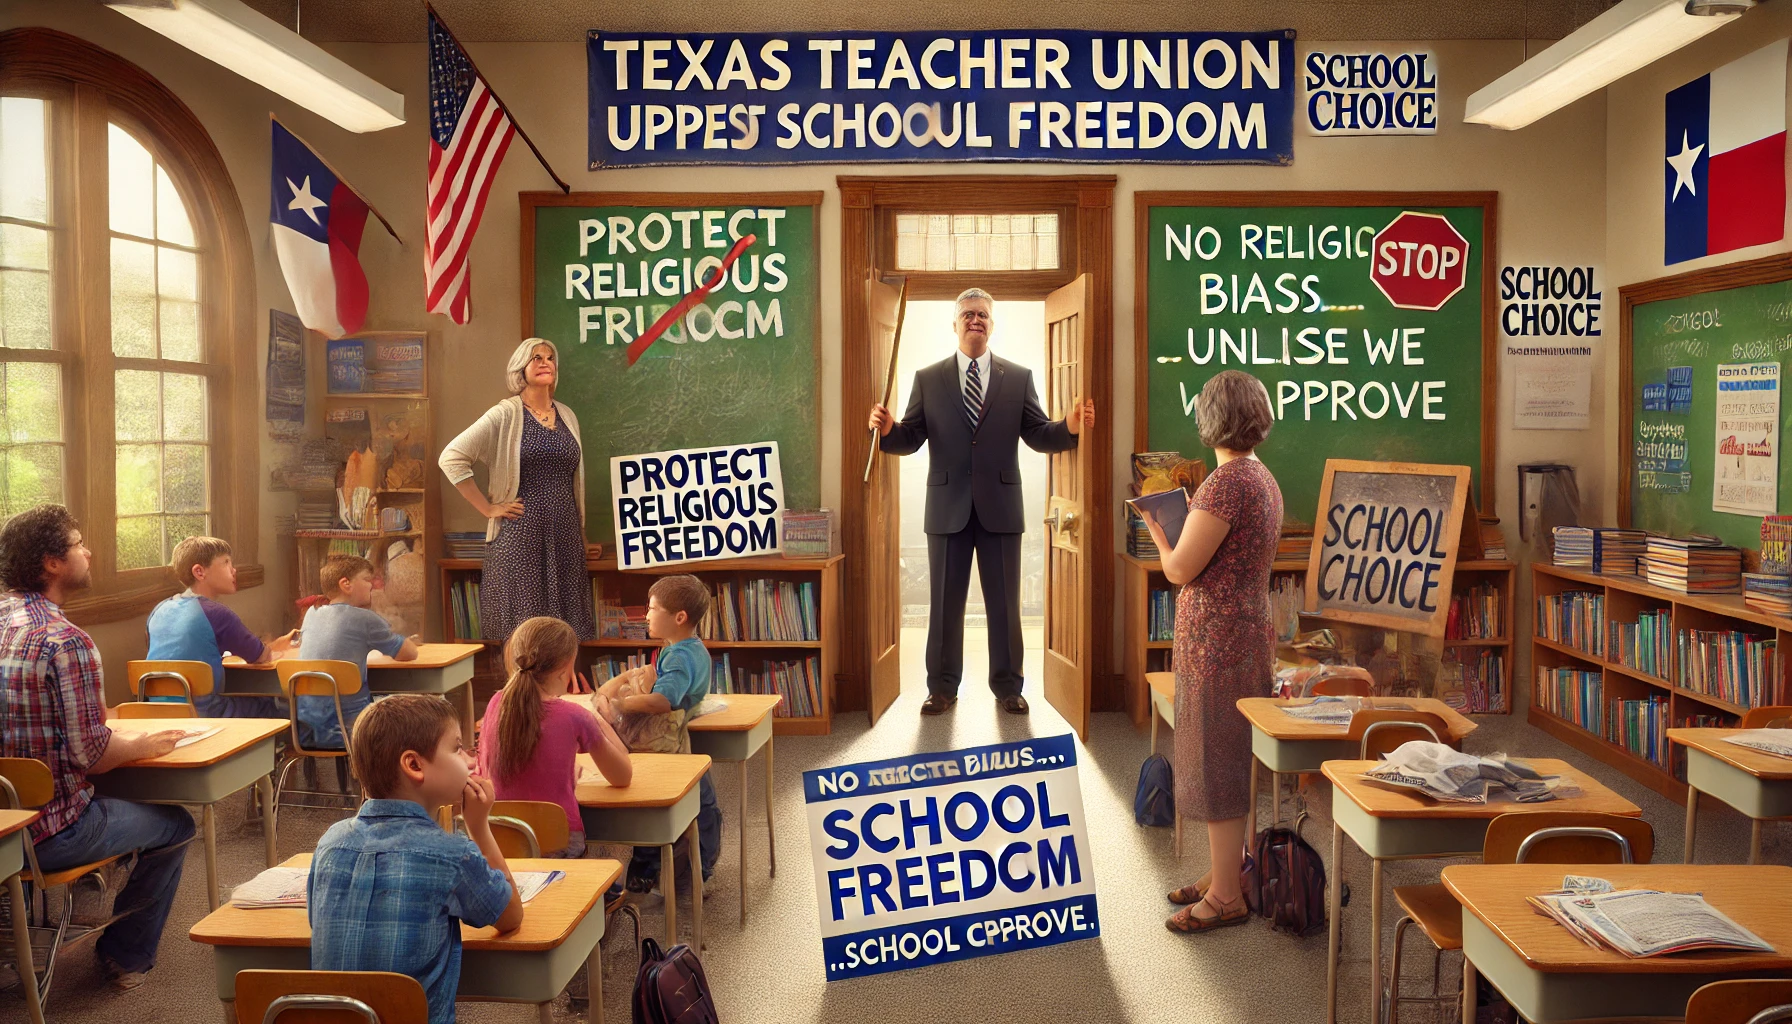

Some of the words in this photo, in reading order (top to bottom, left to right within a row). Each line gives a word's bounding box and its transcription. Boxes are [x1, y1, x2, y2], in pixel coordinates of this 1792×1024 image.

[603, 40, 792, 91] TEXAS
[808, 38, 1071, 90] TEACHER
[1091, 38, 1280, 90] UNION
[1306, 52, 1436, 91] SCHOOL
[1009, 101, 1268, 151] FREEDOM
[1308, 91, 1437, 131] CHOICE
[578, 208, 787, 257] PROTECT
[1164, 223, 1222, 261] NO
[565, 252, 789, 300] RELIGIOUS
[1378, 240, 1461, 280] STOP
[1500, 266, 1602, 300] SCHOOL
[1502, 303, 1602, 337] CHOICE
[1362, 327, 1426, 366] WE
[1257, 380, 1446, 421] PPROVE
[619, 446, 773, 494] PROTECT
[618, 481, 778, 530] RELIGIOUS
[621, 517, 777, 566] FREEDOM
[1322, 503, 1447, 559] SCHOOL
[1317, 553, 1442, 613] CHOICE
[817, 770, 860, 796] NO
[822, 780, 1071, 860] SCHOOL
